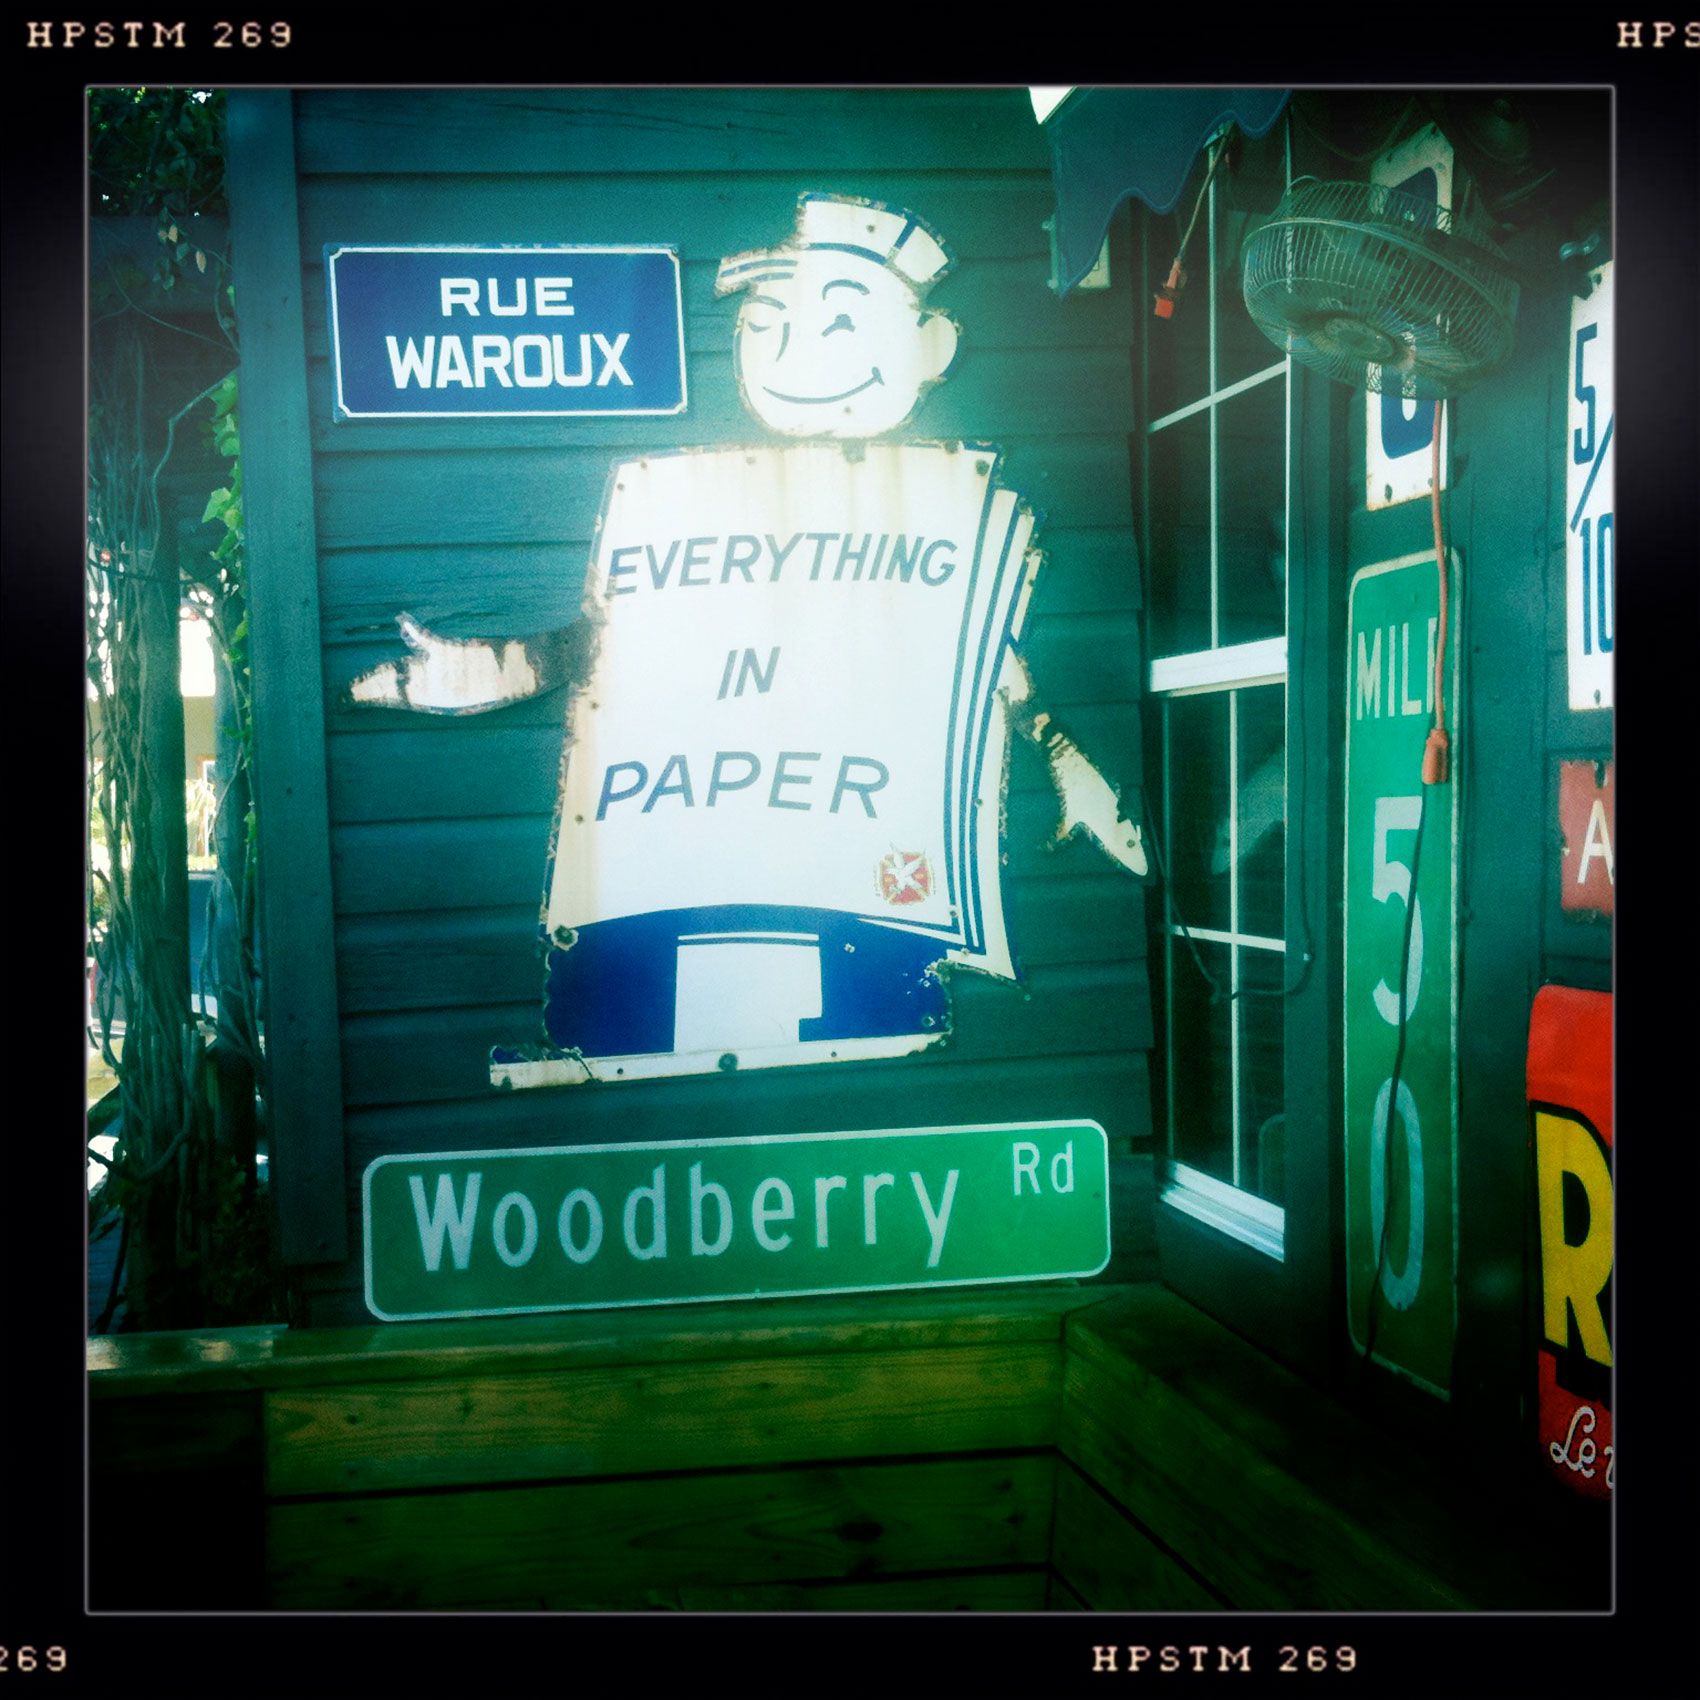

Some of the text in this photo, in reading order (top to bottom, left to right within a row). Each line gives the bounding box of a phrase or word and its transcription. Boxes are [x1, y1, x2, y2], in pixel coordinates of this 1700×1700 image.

[440, 277, 575, 316] RUE
[385, 333, 634, 389] WAROUX
[606, 532, 958, 596] EVERYTHING
[717, 646, 781, 700] IN
[594, 751, 890, 822] PAPER
[408, 1141, 1075, 1272] Woodberry Rd
